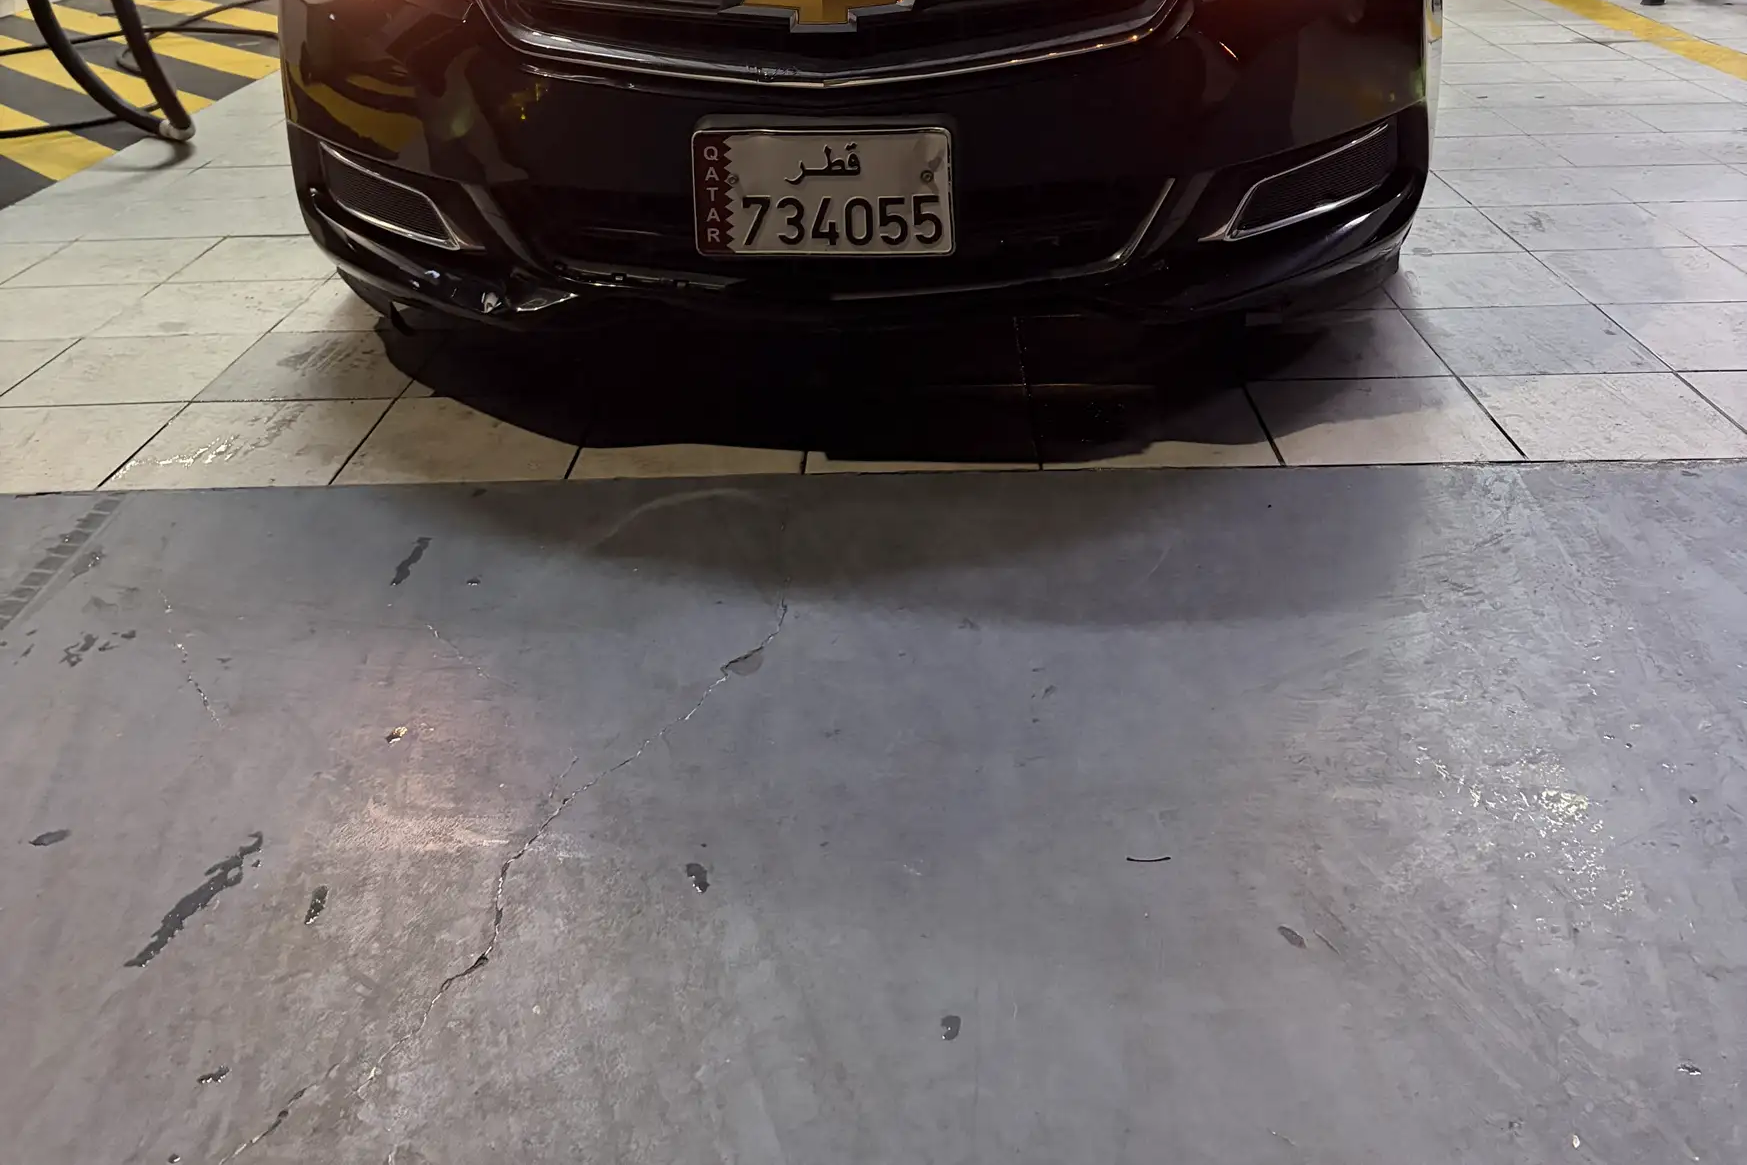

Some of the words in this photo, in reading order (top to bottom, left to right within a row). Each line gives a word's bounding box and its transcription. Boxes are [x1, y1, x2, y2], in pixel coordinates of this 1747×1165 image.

[783, 141, 862, 185] قطر
[703, 145, 721, 243] QATAR
[742, 193, 944, 246] 734055
